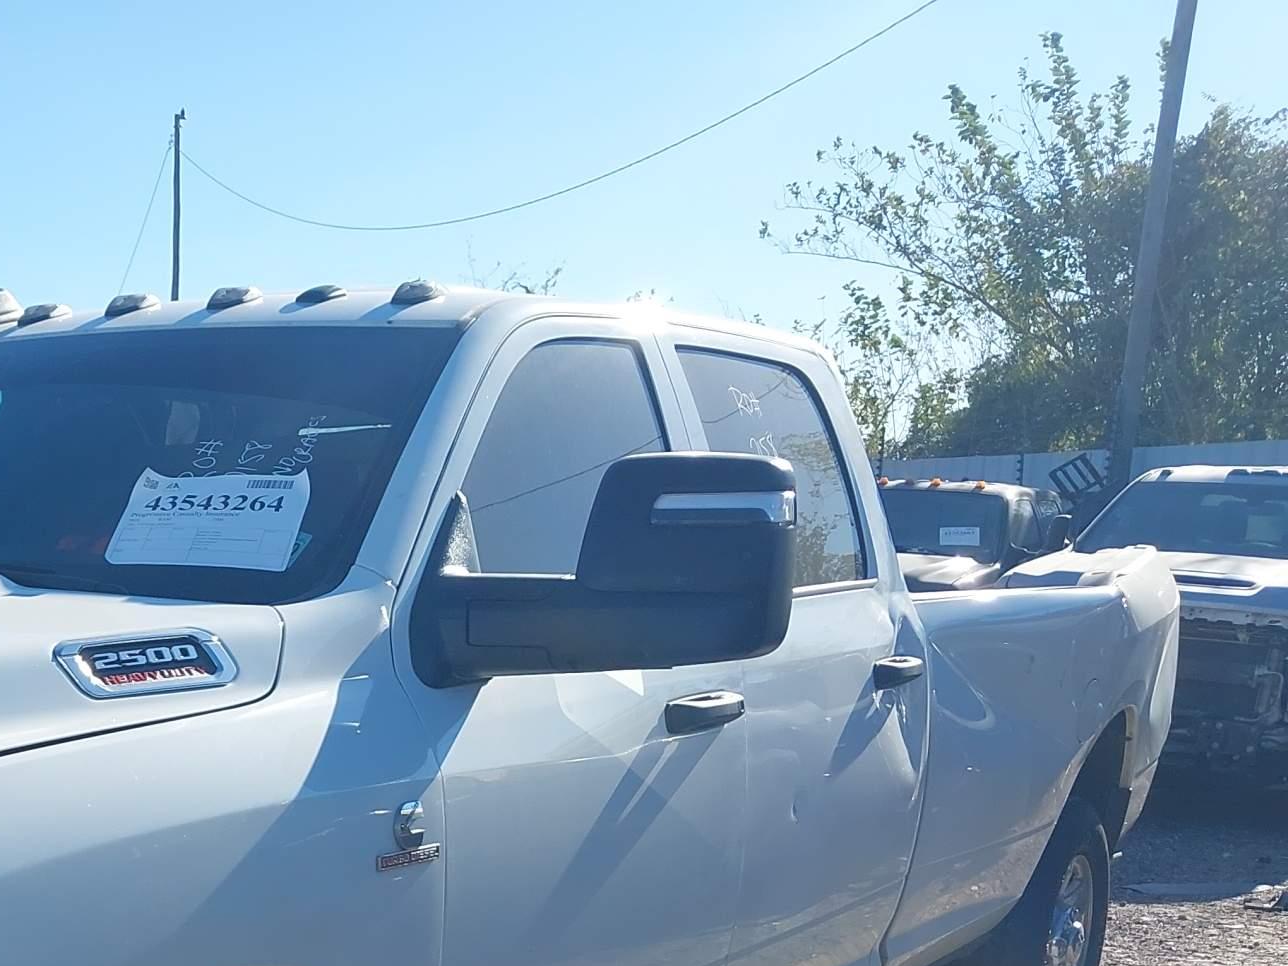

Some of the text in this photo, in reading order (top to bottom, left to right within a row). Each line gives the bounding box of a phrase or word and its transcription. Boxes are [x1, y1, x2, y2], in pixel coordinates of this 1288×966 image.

[144, 494, 285, 513] 43543264
[94, 644, 198, 670] 2500
[103, 671, 161, 686] HEAVY
